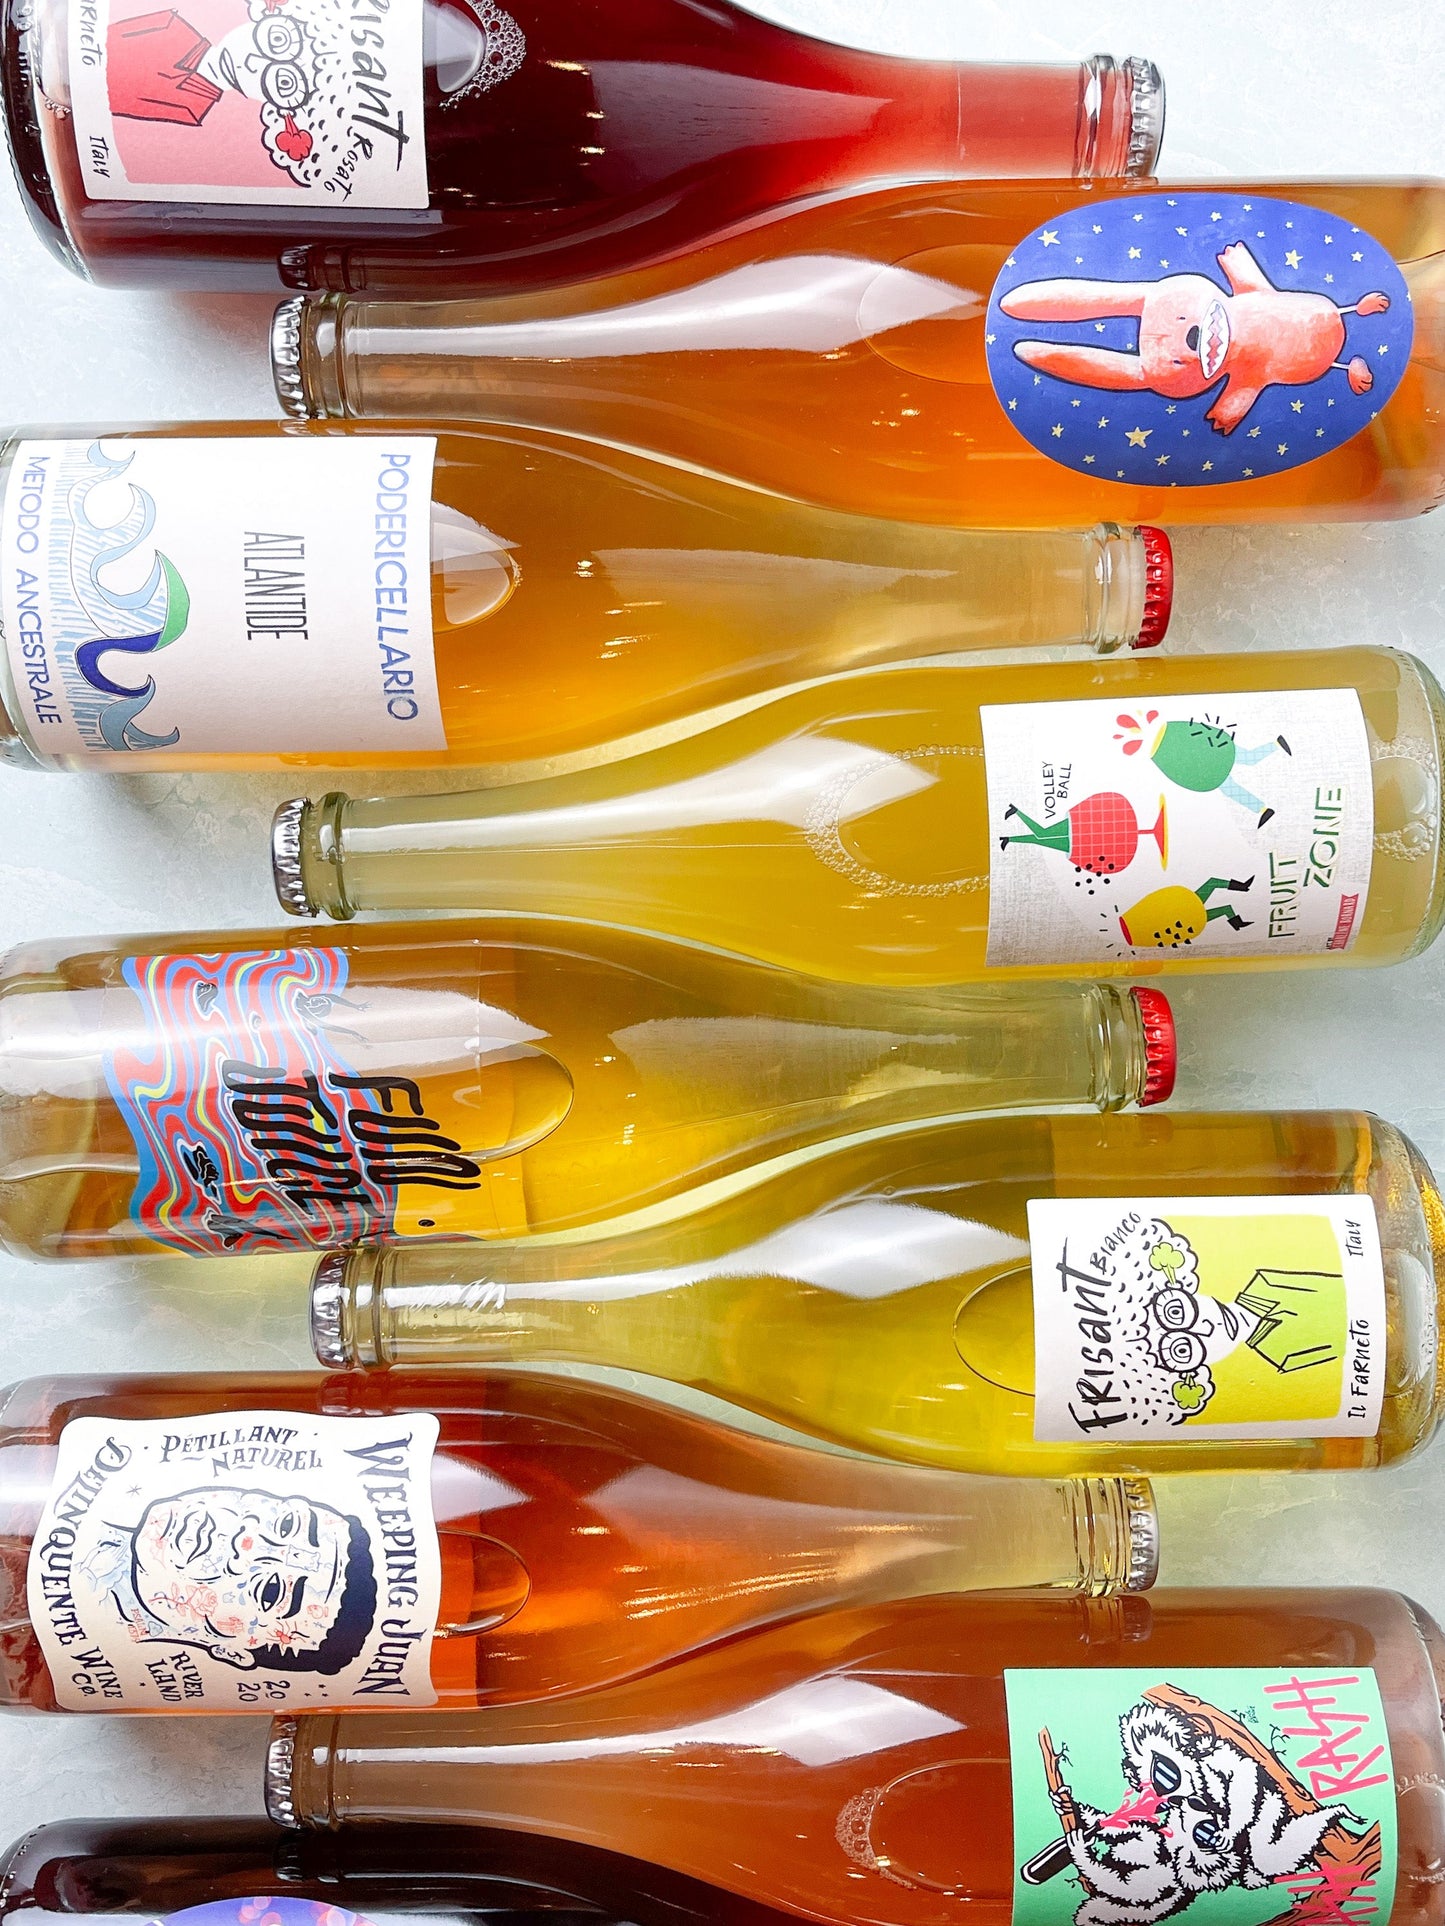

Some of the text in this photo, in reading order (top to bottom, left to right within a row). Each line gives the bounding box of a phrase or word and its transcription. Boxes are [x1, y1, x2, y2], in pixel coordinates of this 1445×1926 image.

[16, 456, 62, 724] METODO ANCESTRALE
[244, 531, 309, 641] ATLANTIDE
[374, 453, 419, 722] PODERICELLARIO
[1042, 760, 1056, 819] VOLLEY
[1057, 763, 1072, 799] BALL
[1303, 787, 1343, 888] ZONE
[1268, 849, 1300, 939] FRUIT
[222, 1059, 386, 1218] JUICE
[329, 1071, 481, 1190] FUN
[211, 1447, 323, 1479] NATUREL
[39, 1436, 132, 1700] DELINQUENTE WINE
[344, 1431, 428, 1697] WEEPING JUAN
[145, 1659, 184, 1702] LAND
[169, 1650, 204, 1699] RIVER
[236, 1681, 260, 1702] 20
[262, 1680, 291, 1700] 20
